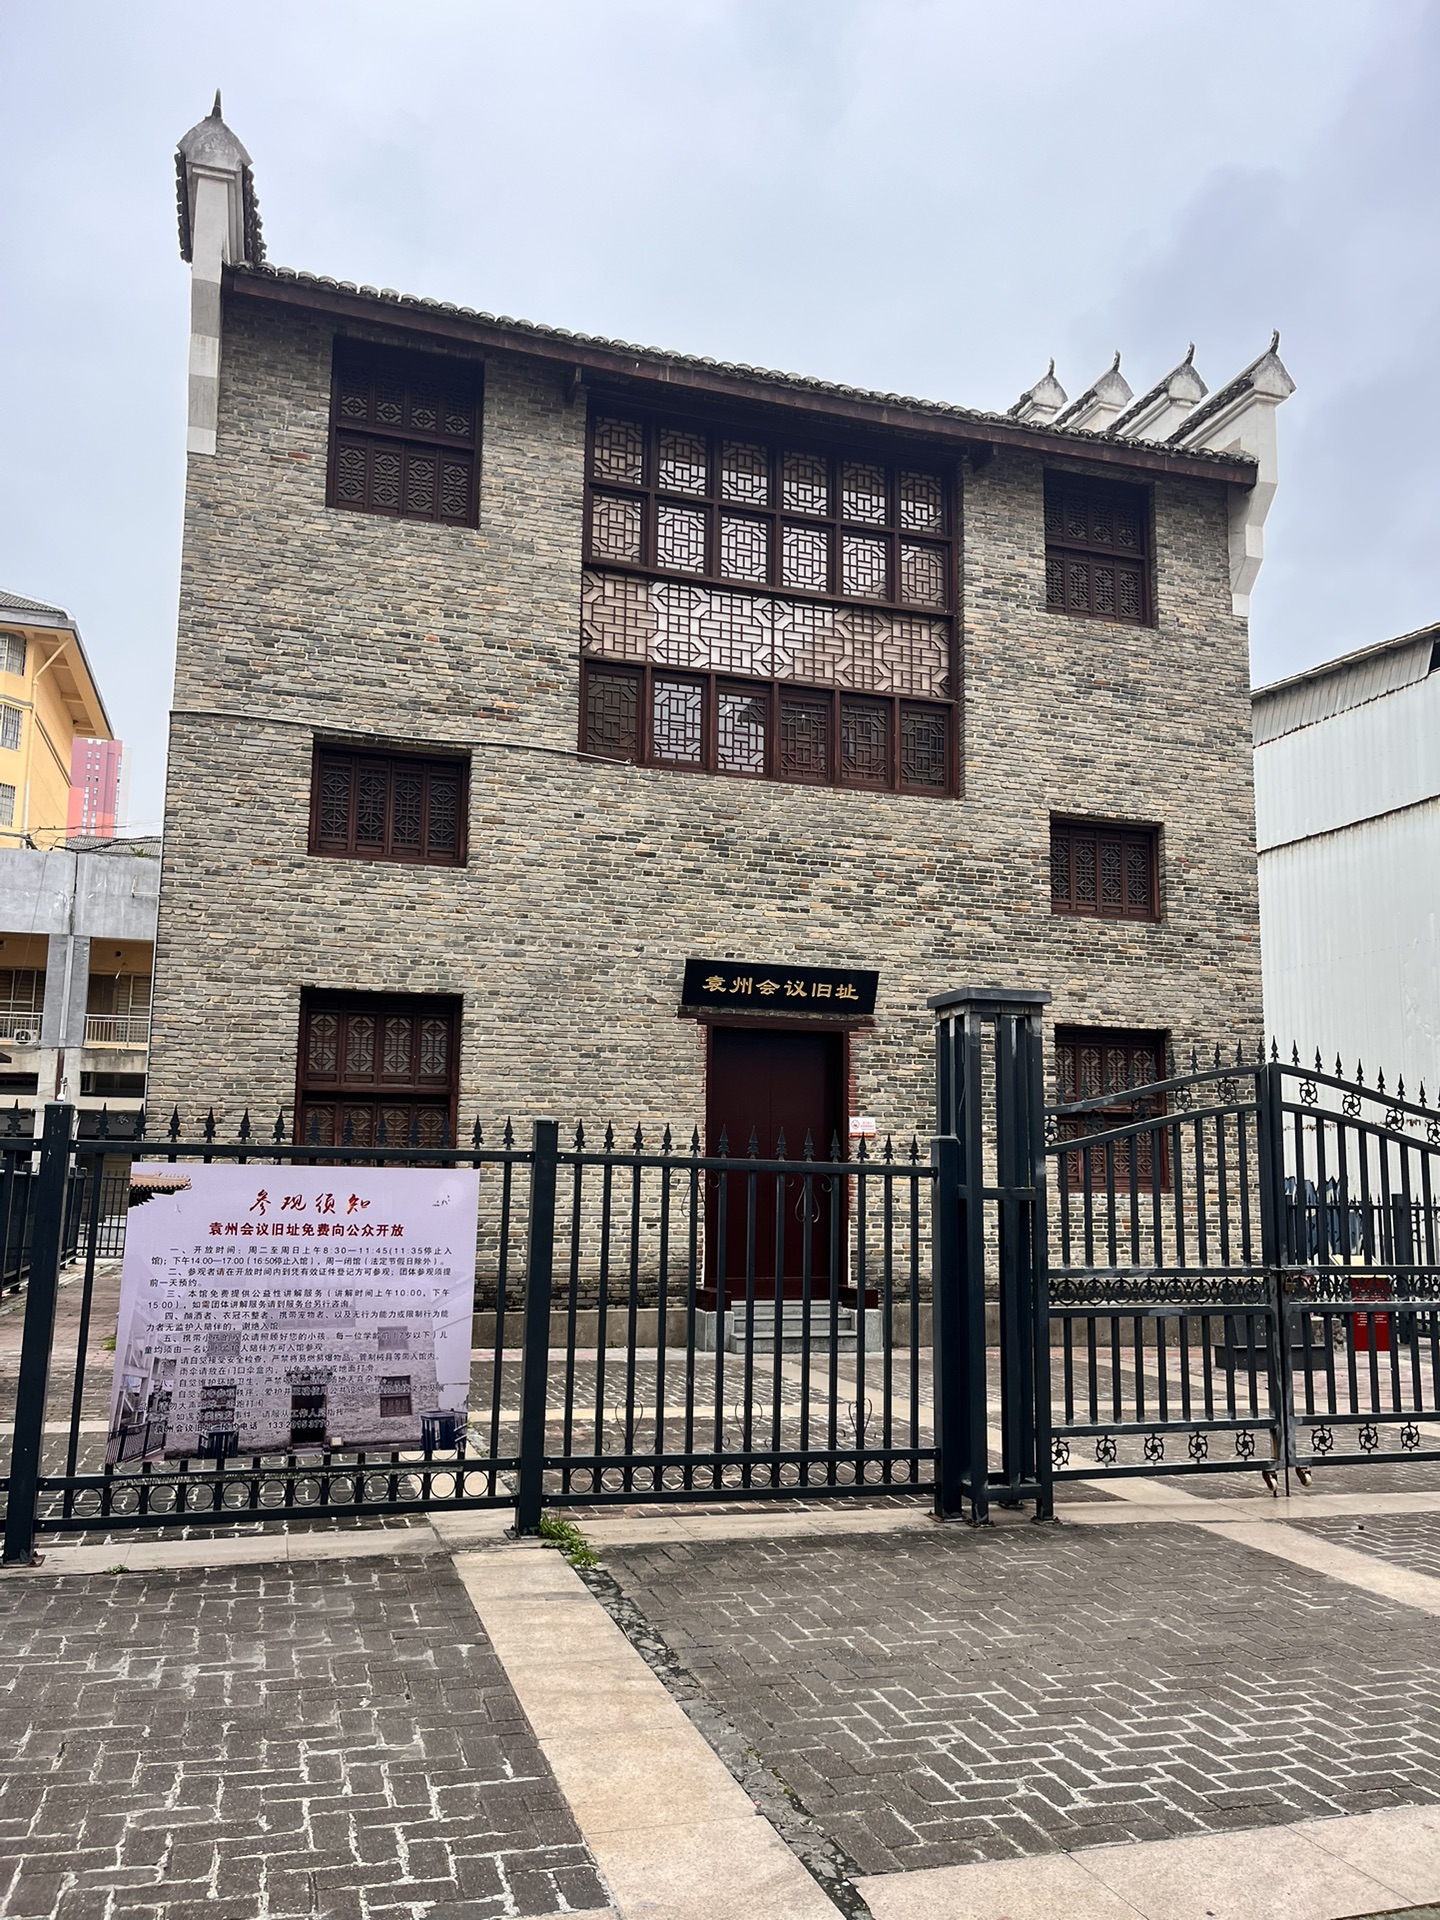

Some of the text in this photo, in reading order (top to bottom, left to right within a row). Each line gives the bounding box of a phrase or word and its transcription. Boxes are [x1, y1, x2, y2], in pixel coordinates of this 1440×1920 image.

[702, 976, 858, 1000] 袁州会议旧址
[249, 1190, 371, 1216] 参观须知
[208, 1222, 404, 1237] 袁州会议旧址免费向公众开放
[149, 1278, 202, 1287] 前一天预约。
